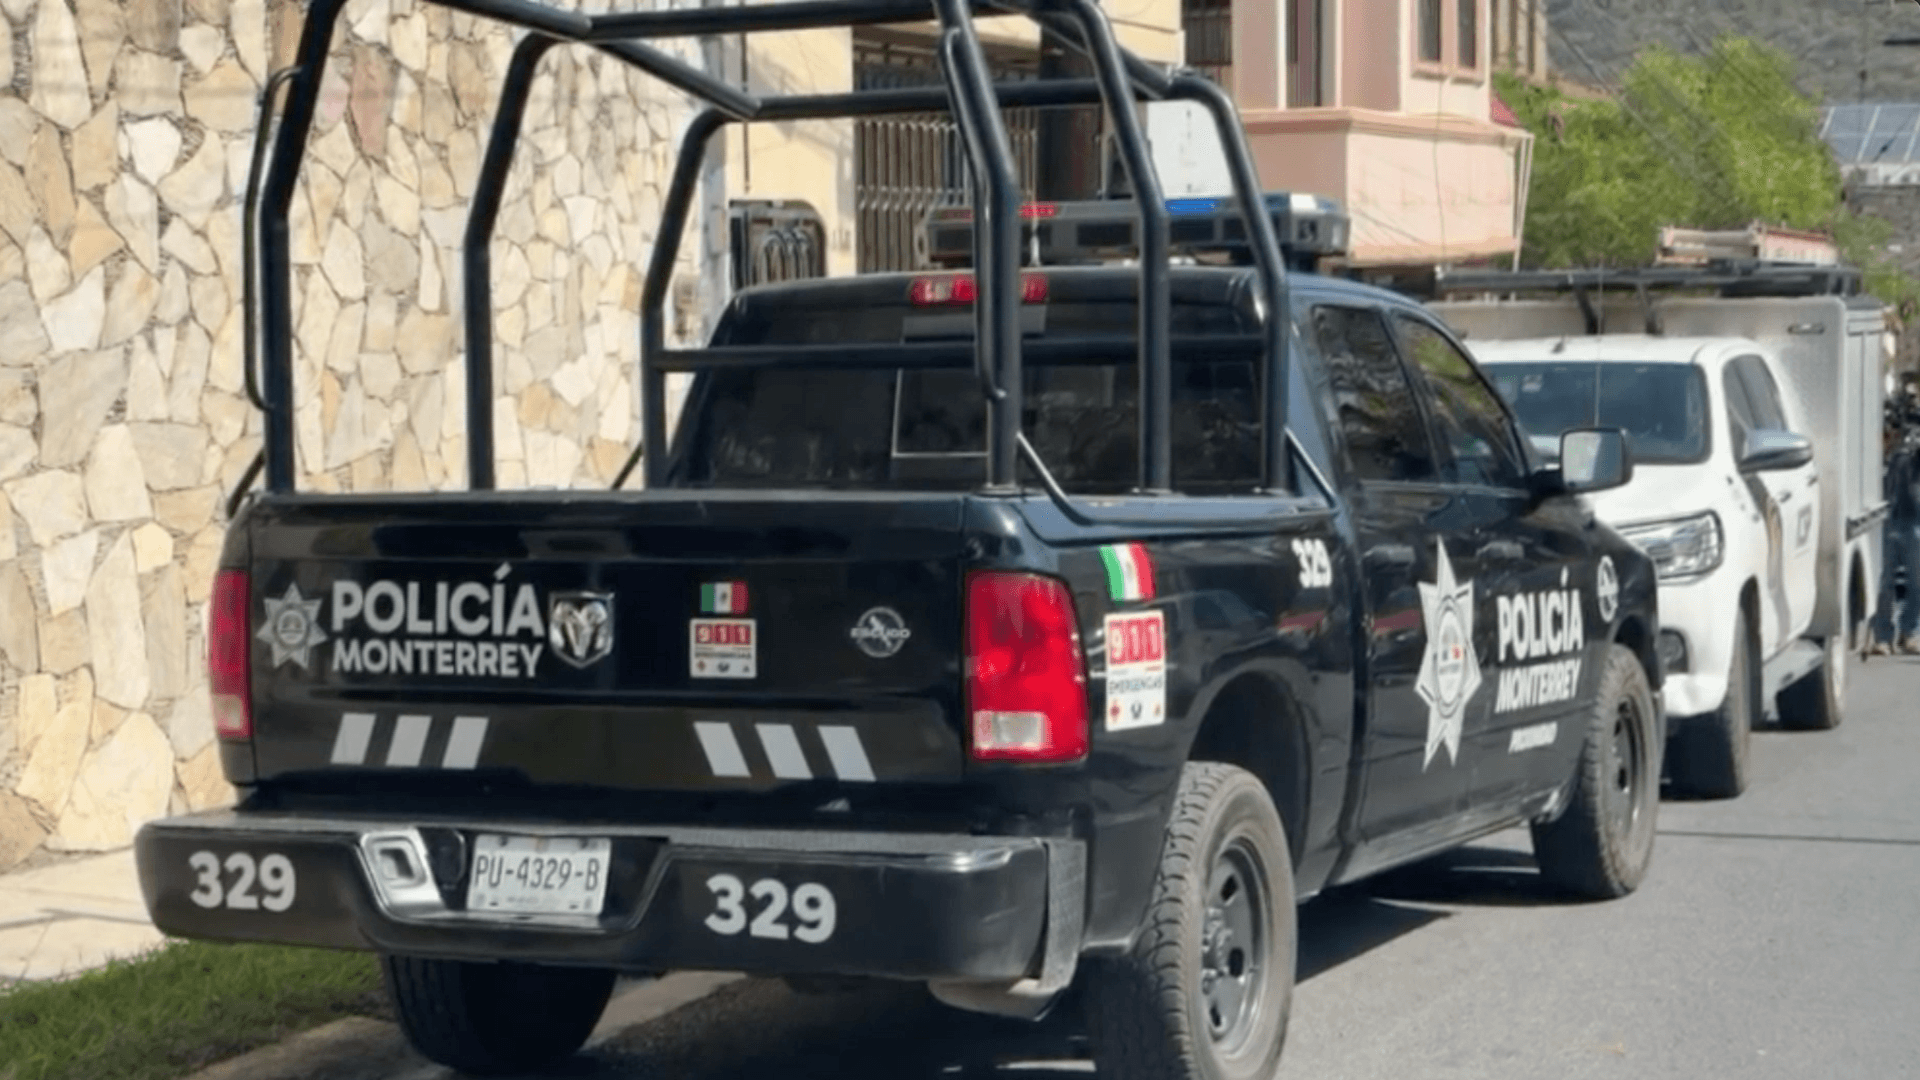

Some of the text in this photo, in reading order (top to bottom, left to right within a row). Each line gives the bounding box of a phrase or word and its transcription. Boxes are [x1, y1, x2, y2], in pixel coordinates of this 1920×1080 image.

[1292, 538, 1332, 588] 329
[332, 562, 545, 636] POLICÍA
[1497, 566, 1584, 662] POLICÍA
[332, 638, 543, 677] MONTERREY
[699, 627, 747, 642] 911
[1111, 624, 1158, 659] 911
[1495, 658, 1582, 714] MONTERREY
[188, 851, 296, 912] 329
[474, 854, 600, 891] PU-4329-B
[704, 874, 837, 944] 329
